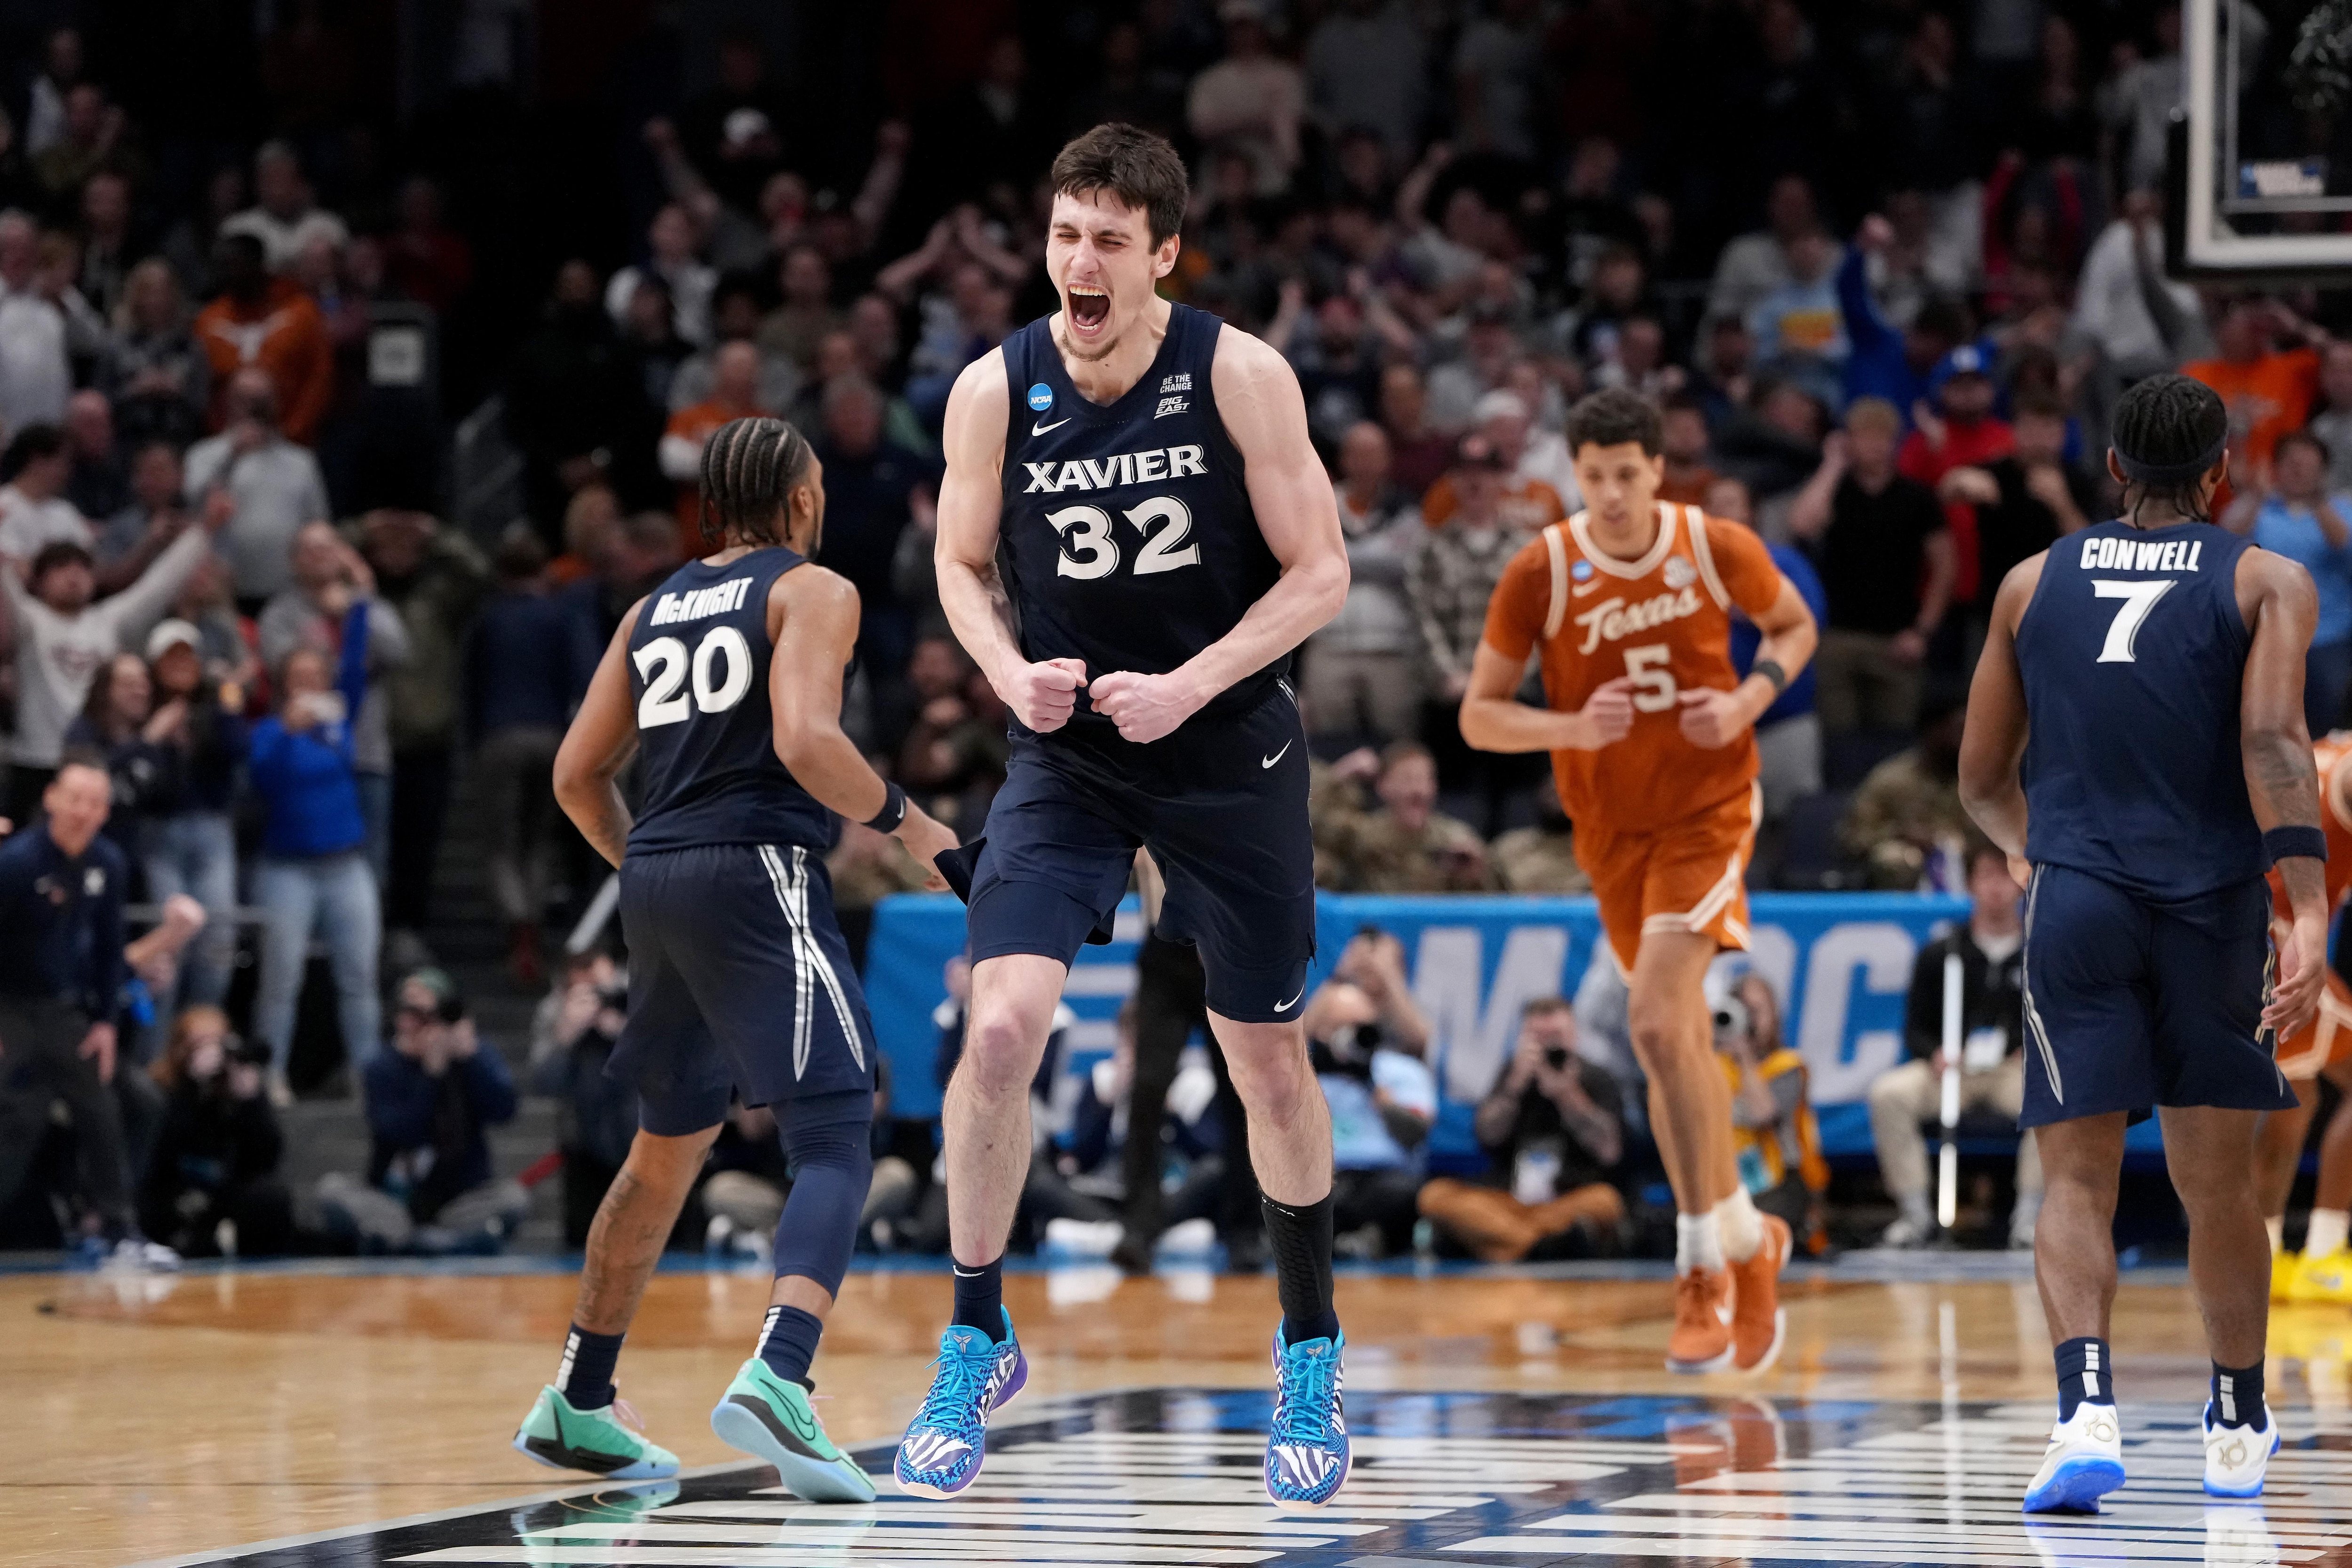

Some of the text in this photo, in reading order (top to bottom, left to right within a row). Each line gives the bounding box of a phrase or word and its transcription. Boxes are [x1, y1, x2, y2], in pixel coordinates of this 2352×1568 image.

[1031, 395, 1051, 404] NCAA
[1158, 396, 1183, 407] BIG
[1160, 382, 1192, 394] CHANGE
[1163, 374, 1190, 386] BE THE
[1155, 402, 1190, 414] EAST
[1022, 444, 1208, 493] XAVIER
[1045, 495, 1200, 580] 32
[2080, 537, 2202, 572] CONWELL
[650, 577, 754, 626] McKNIGHT
[1574, 586, 1703, 655] Texas
[2090, 580, 2178, 663] 7
[632, 625, 753, 729] 20
[1622, 642, 1677, 713] 5
